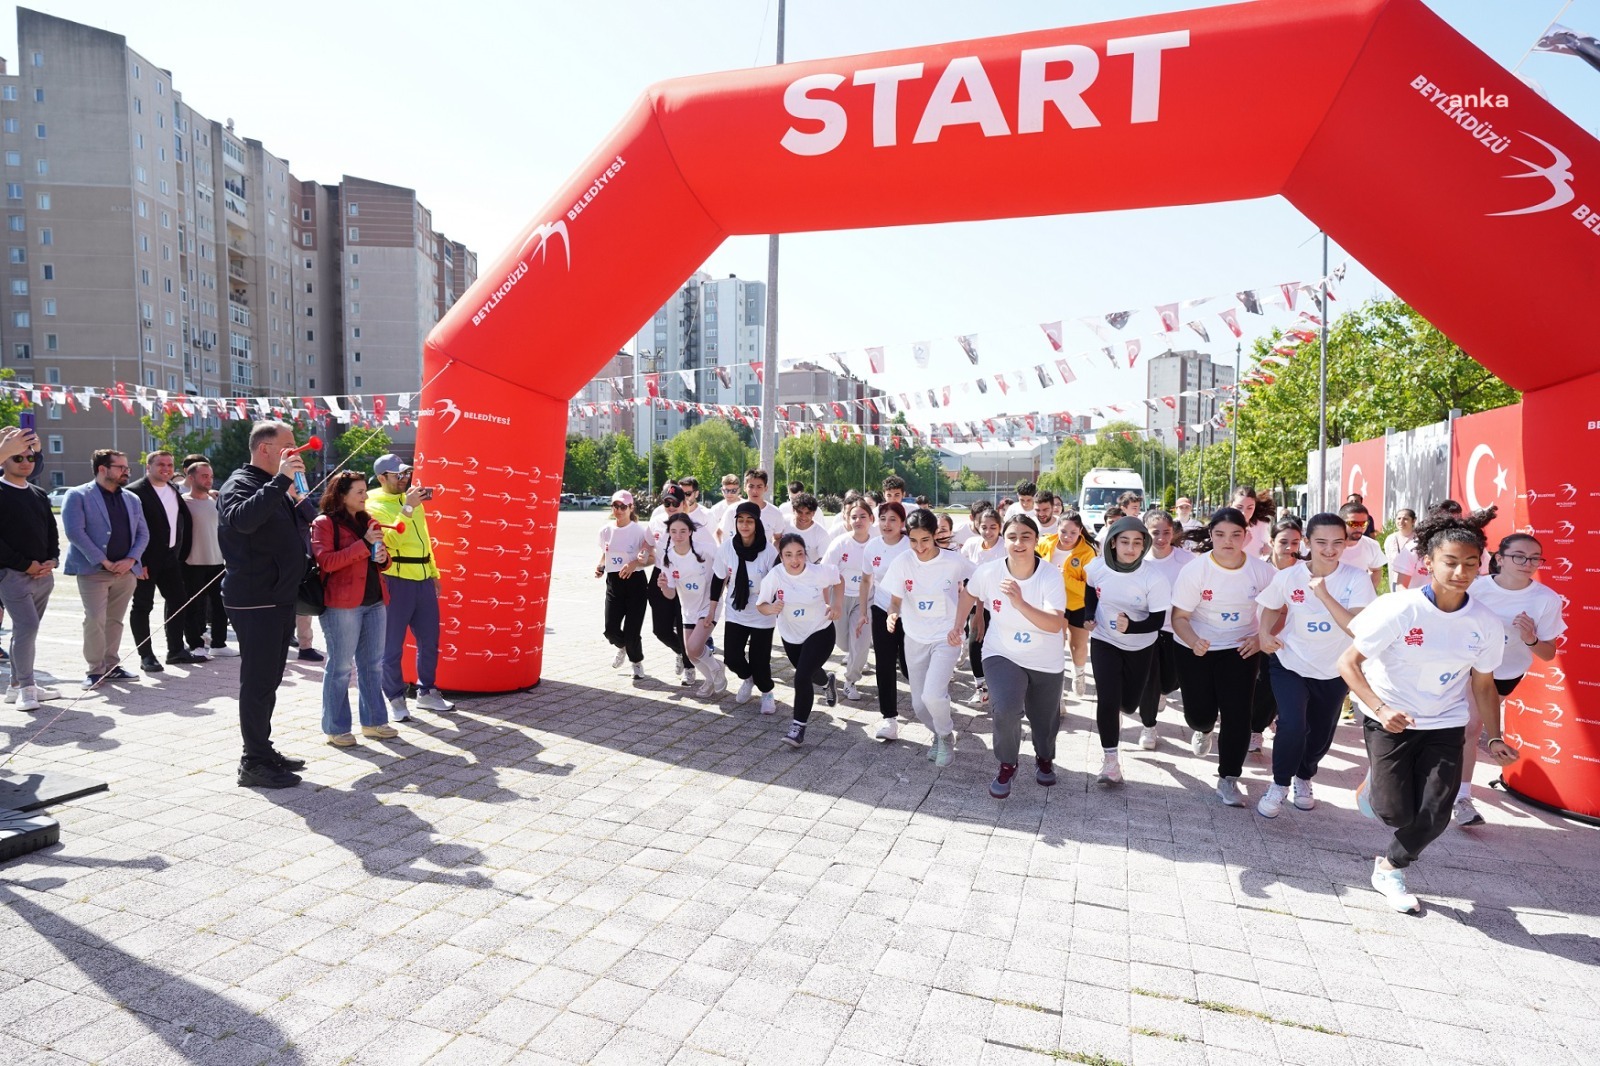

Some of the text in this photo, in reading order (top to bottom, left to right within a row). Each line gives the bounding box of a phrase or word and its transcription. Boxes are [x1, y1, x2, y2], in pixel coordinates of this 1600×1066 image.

[779, 29, 1190, 156] START
[471, 155, 626, 326] BEYLİKDÜZÜ BELEDİYESİ
[463, 411, 511, 426] BELEDİYESİ
[611, 556, 623, 565] 39
[685, 582, 699, 591] 96
[918, 600, 934, 611] 87
[793, 608, 805, 618] 91
[1221, 612, 1239, 622] 93
[1307, 621, 1331, 632] 50
[1014, 632, 1031, 643] 42
